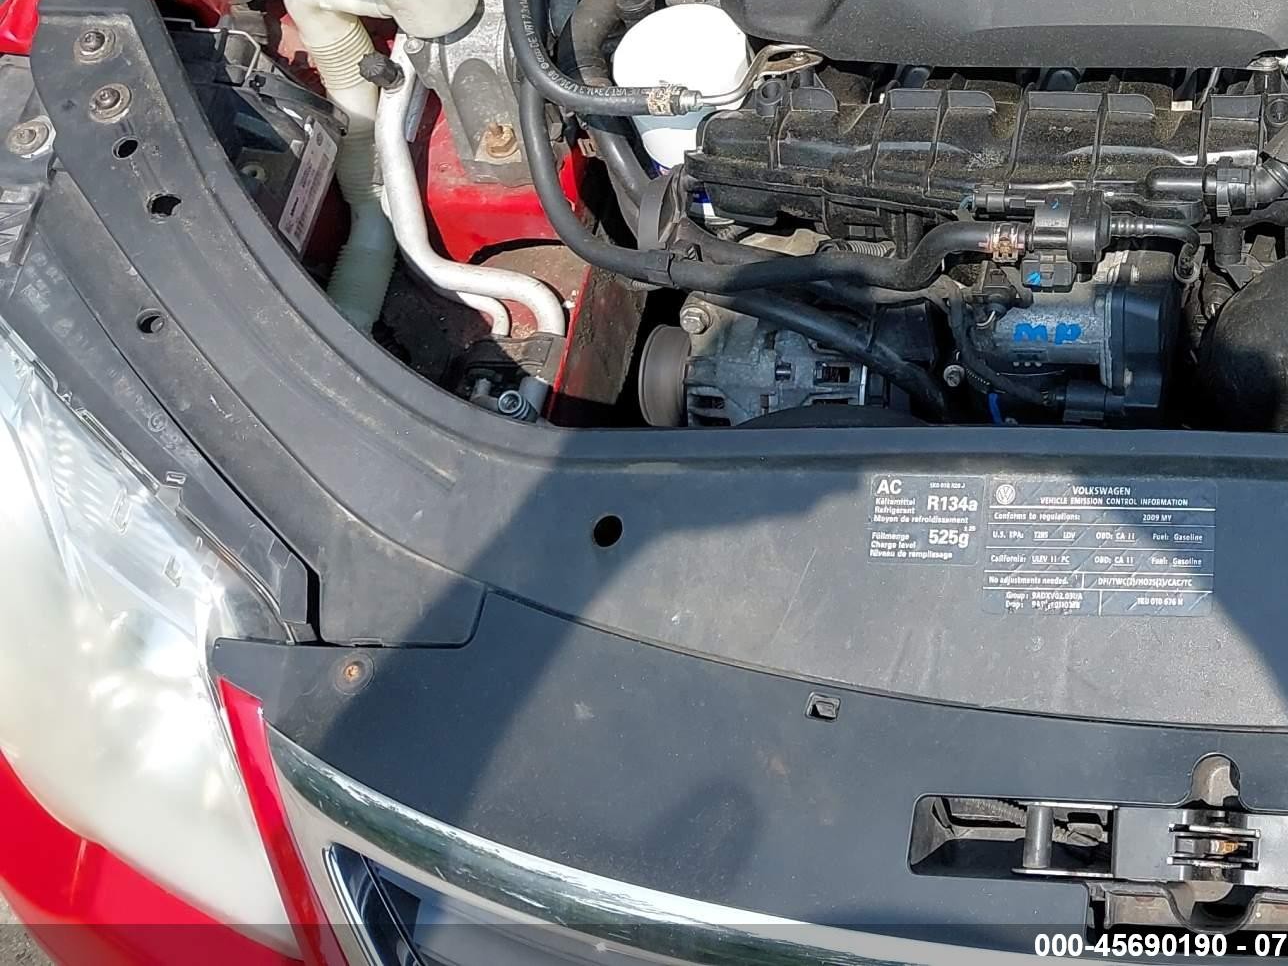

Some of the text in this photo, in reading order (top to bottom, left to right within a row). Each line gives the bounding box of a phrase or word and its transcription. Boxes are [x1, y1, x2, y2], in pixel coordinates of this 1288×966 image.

[876, 479, 902, 494] AC
[1072, 486, 1131, 496] VOLKSWAGEN
[927, 495, 979, 512] R134a
[1040, 497, 1189, 506] VEHICLE EMISSION CONTROL INFORMATION
[874, 506, 915, 515] Refrigerant
[873, 515, 969, 524] Moyen de refroidissement
[993, 512, 1081, 521] Conforms to regulations:
[1142, 514, 1172, 522] 2009 MY
[871, 532, 910, 541] Füllmenge
[928, 529, 970, 549] 525g
[1115, 532, 1126, 540] CA
[1152, 533, 1170, 541] Fuel:
[1173, 533, 1203, 541] Gasoline
[870, 541, 917, 549] Charge level
[869, 549, 953, 559] Niveau de remplissage
[990, 555, 1027, 563] California:
[1031, 555, 1048, 563] ULEV
[1061, 555, 1070, 563] PC
[1094, 556, 1112, 564] OBD:
[1114, 556, 1124, 564] CA
[1172, 557, 1202, 565] Gasoline
[1000, 576, 1041, 585] adjustments
